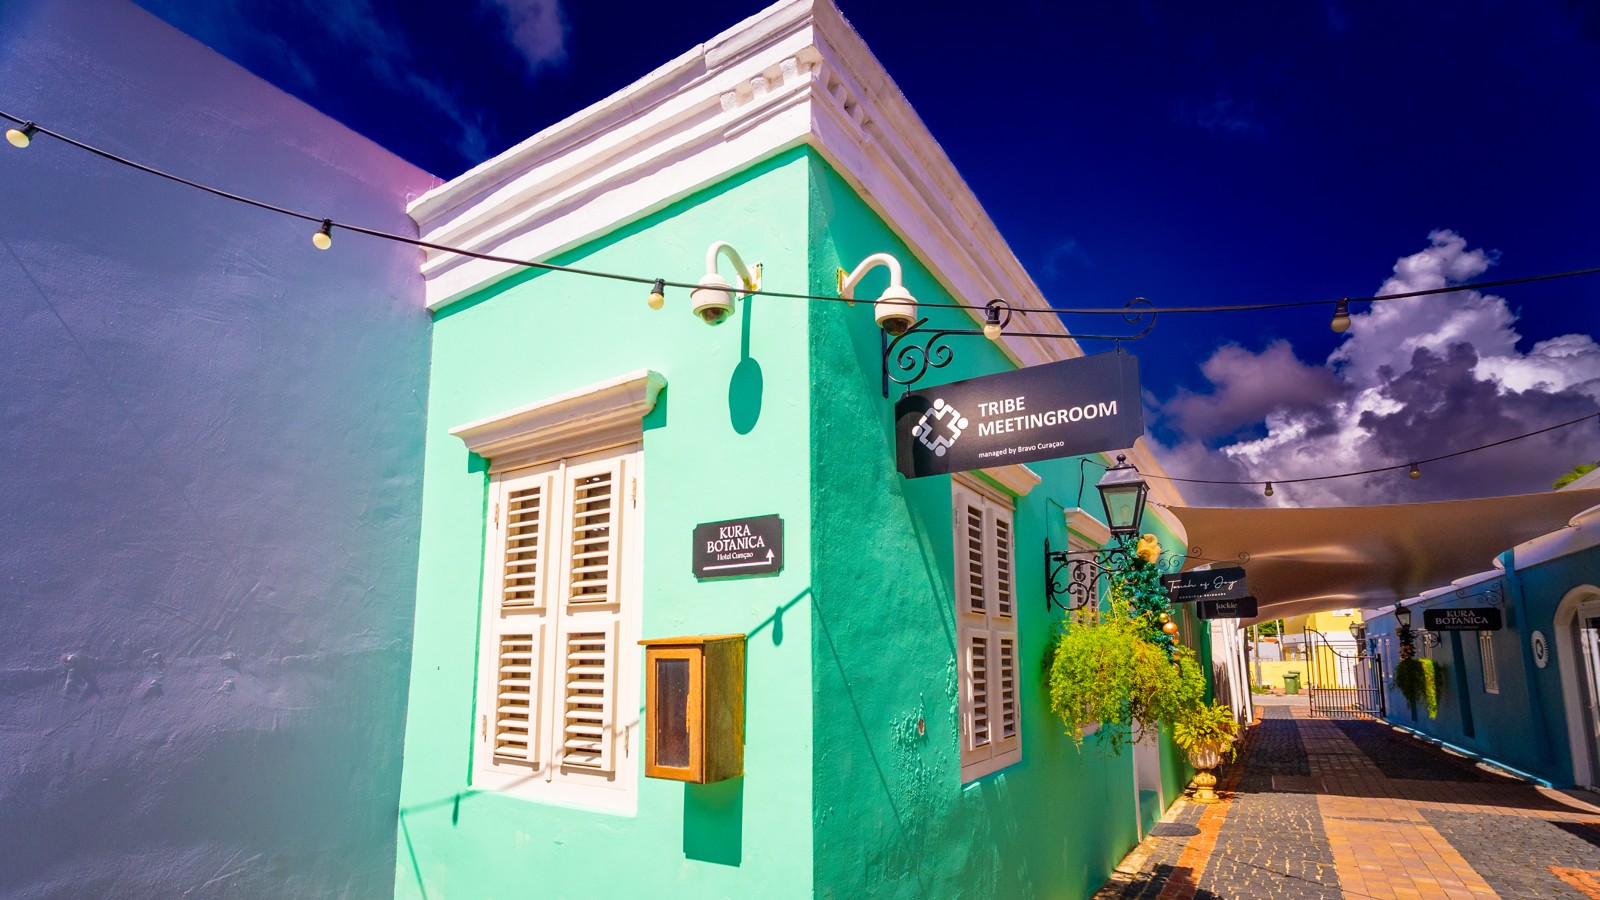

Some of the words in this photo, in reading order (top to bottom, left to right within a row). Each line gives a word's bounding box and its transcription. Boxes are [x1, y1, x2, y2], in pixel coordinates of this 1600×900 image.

[978, 396, 1025, 417] TRIBE
[978, 400, 1118, 437] MEETINGROOM
[978, 449, 1007, 459] managed
[1008, 447, 1016, 456] by
[1017, 444, 1036, 454] Bravo
[1037, 440, 1065, 451] Curaçao
[719, 524, 751, 539] KURA
[706, 535, 765, 553] BOTANICA
[1167, 579, 1197, 593] Touch
[1213, 575, 1238, 591] Joy
[1215, 601, 1238, 610] Jackie
[1435, 616, 1489, 625] BOTANICA
